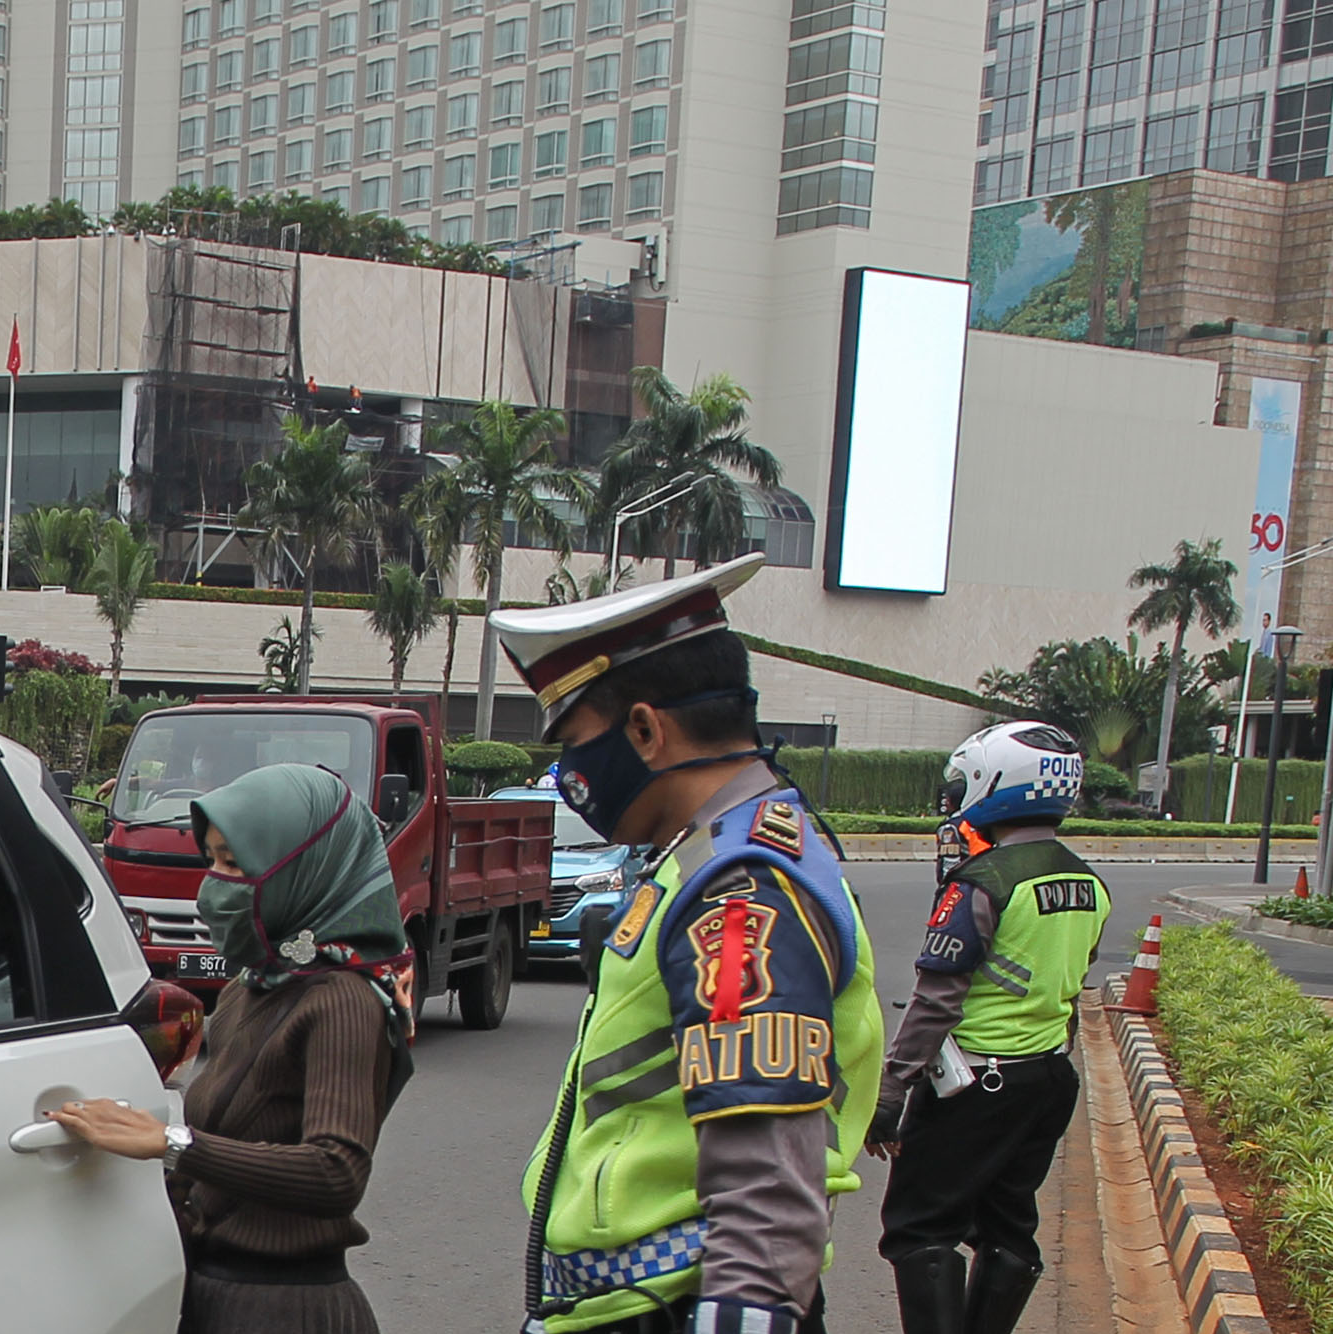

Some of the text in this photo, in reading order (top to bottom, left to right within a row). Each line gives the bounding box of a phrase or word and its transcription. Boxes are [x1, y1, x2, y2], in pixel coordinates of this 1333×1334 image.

[1039, 757, 1082, 777] POLIS
[699, 915, 758, 937] POA
[923, 932, 964, 962] TUR
[673, 1012, 831, 1090] ATUR
